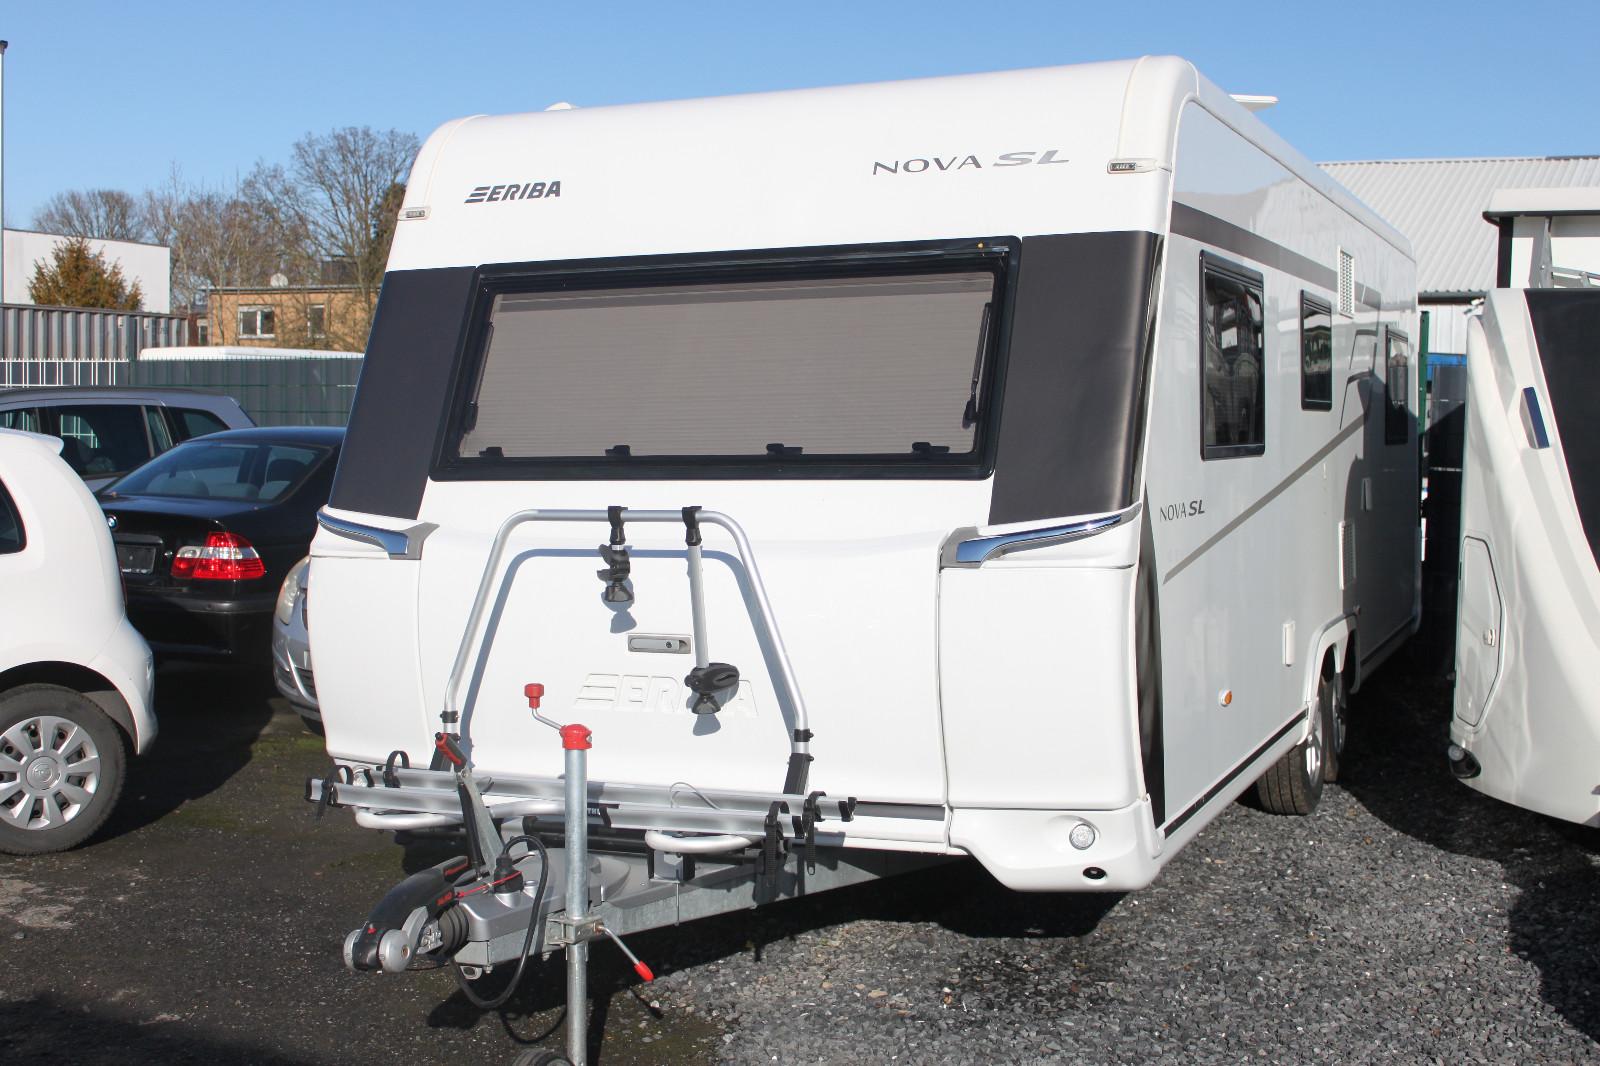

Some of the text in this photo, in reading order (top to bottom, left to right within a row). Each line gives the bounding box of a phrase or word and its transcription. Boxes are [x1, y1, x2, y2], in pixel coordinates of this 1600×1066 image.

[873, 150, 1070, 176] NOVA SL
[484, 180, 561, 203] ERIBA
[1160, 499, 1206, 522] NOVA SL
